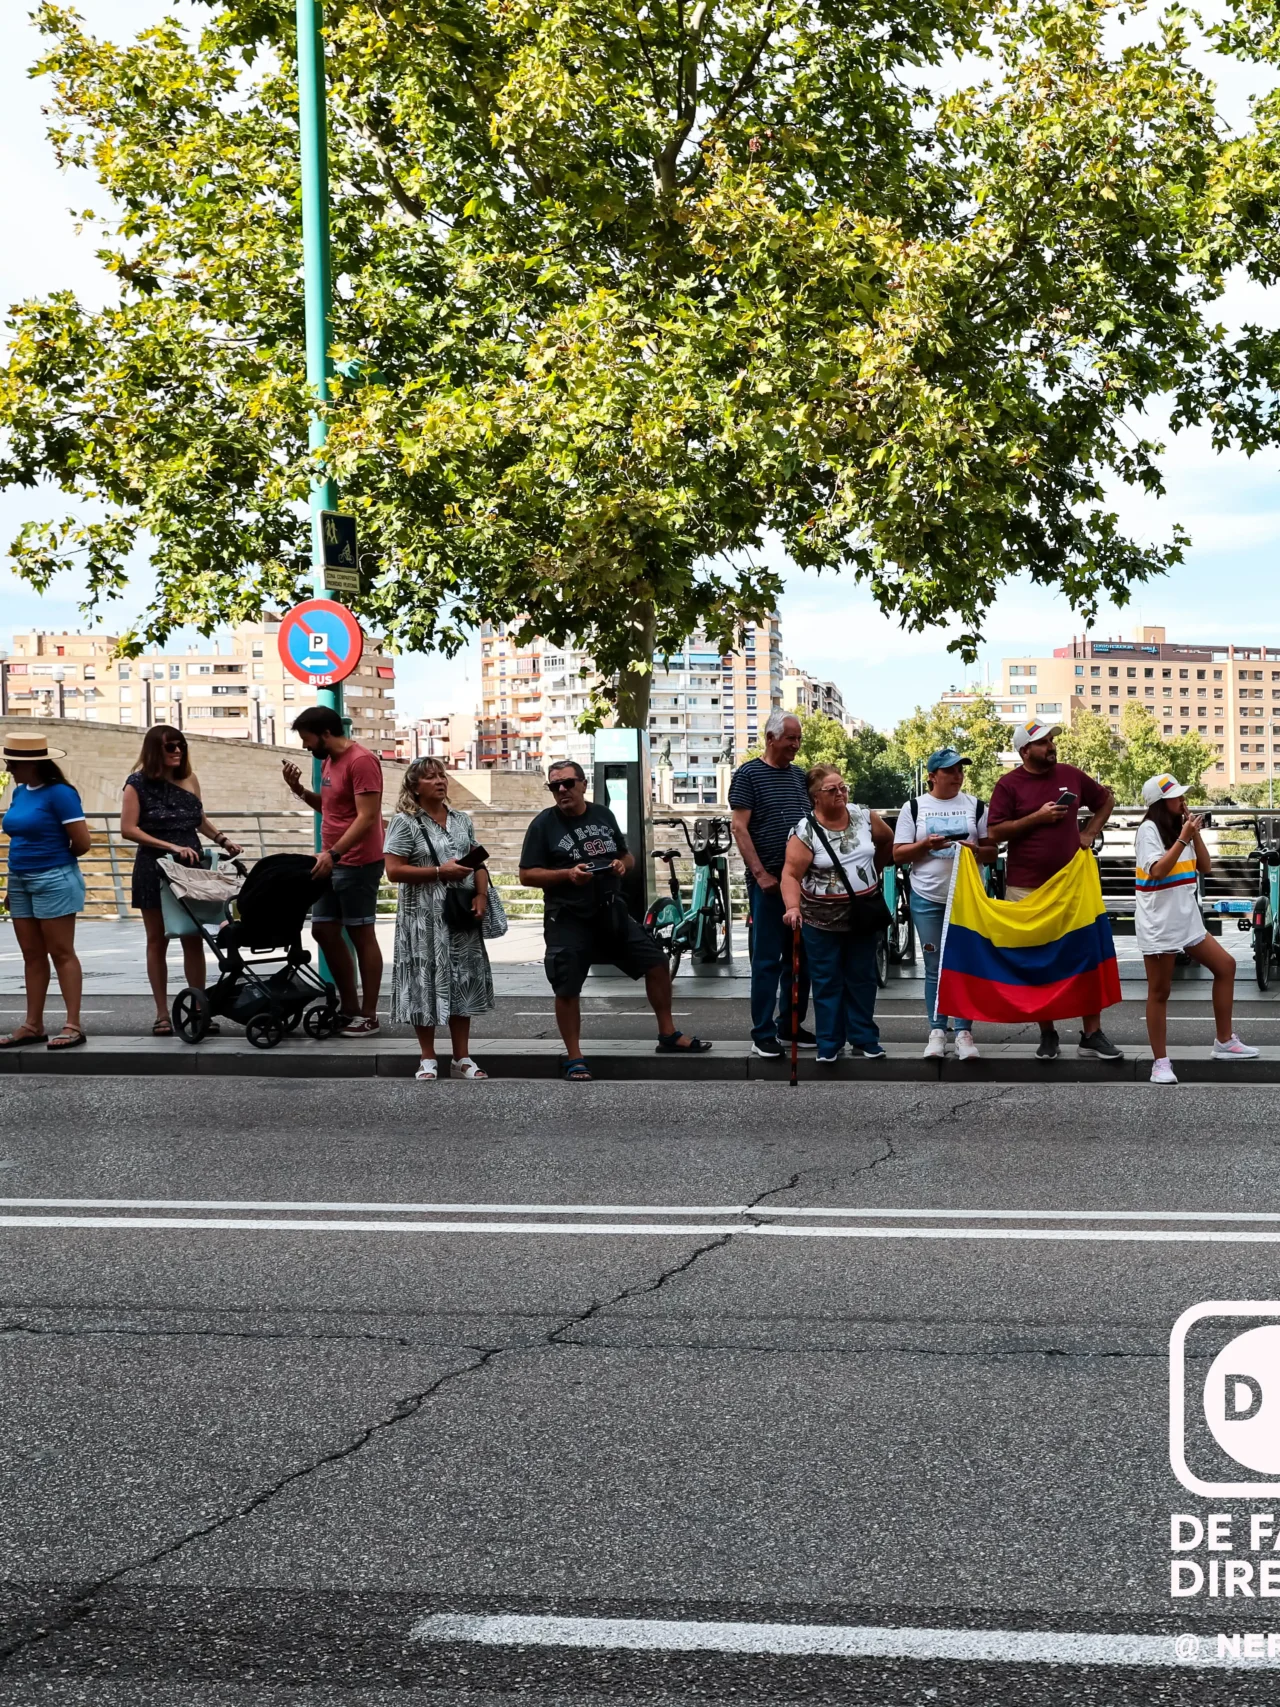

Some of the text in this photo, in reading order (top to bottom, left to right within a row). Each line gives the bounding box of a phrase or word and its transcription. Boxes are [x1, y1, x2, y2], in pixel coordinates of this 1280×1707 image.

[313, 636, 323, 649] P
[308, 675, 333, 685] BUS
[583, 838, 606, 856] 93
